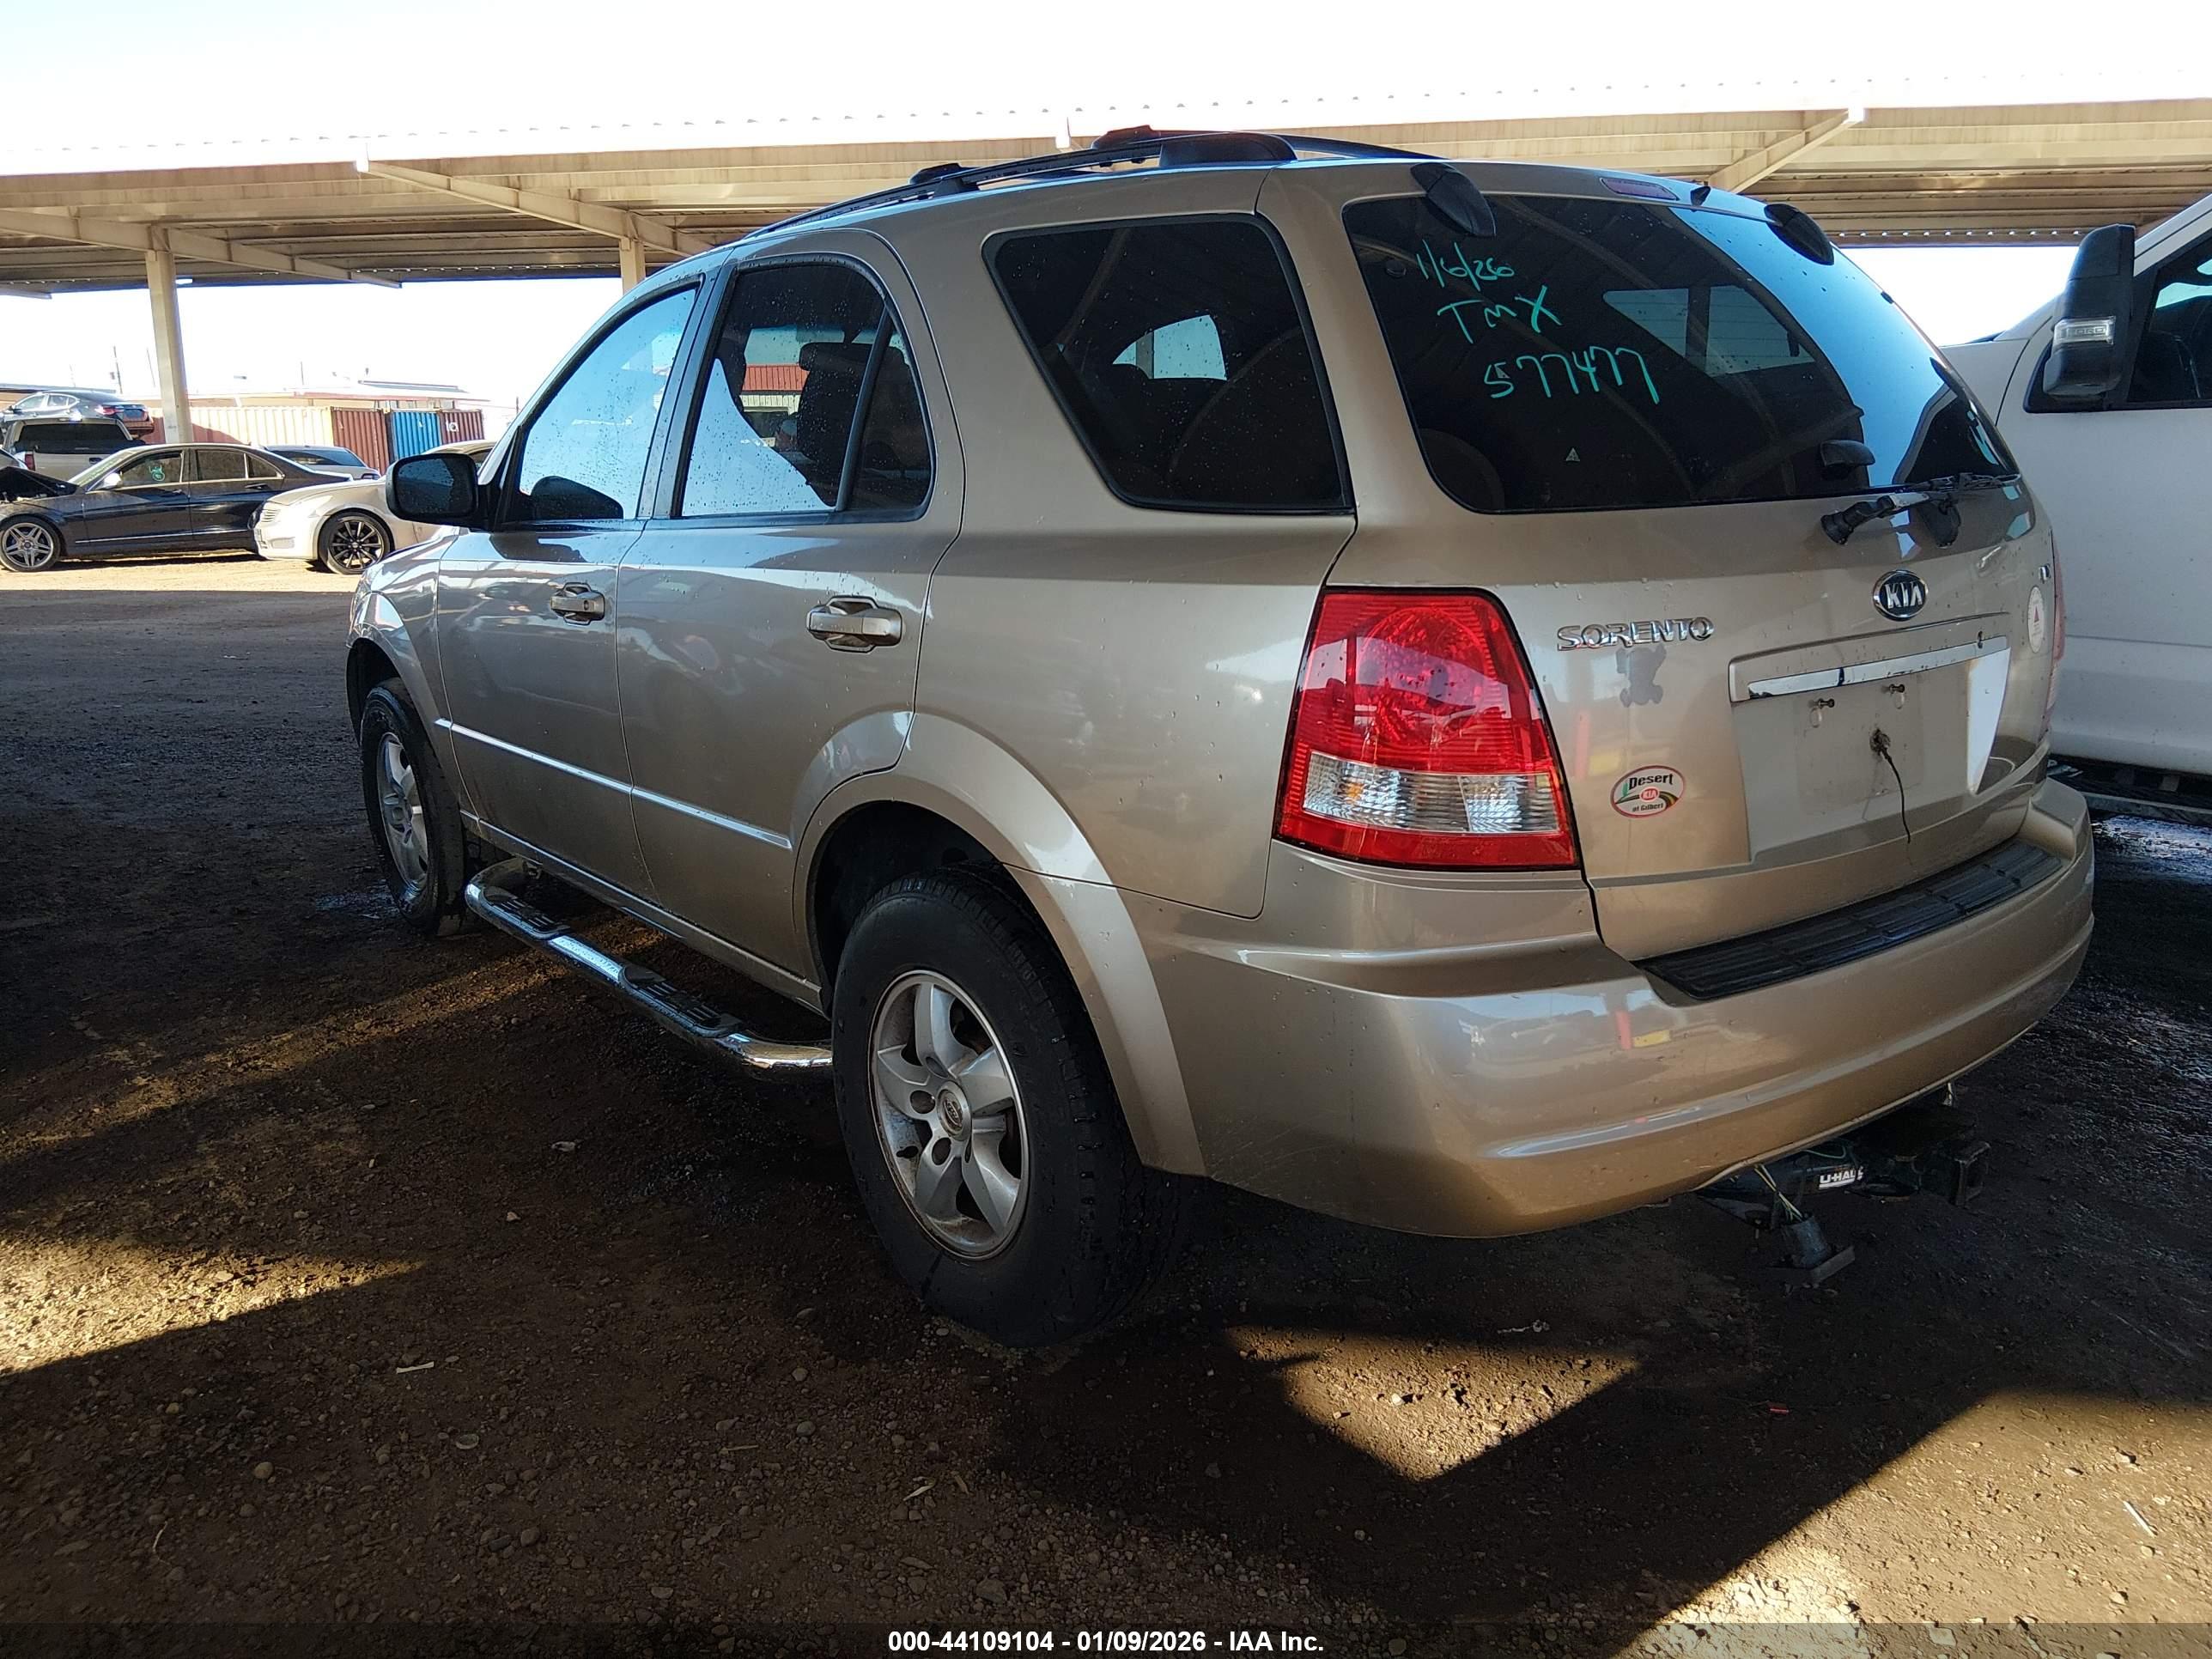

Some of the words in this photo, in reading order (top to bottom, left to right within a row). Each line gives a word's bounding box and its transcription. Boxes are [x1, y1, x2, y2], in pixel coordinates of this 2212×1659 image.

[1416, 239, 1515, 292] 1/6/26
[1484, 345, 1660, 404] 577477
[1885, 581, 1923, 609] KIA
[1557, 617, 1715, 651] SORENTO
[1629, 774, 1673, 790] Desert
[1643, 789, 1656, 799] KIA
